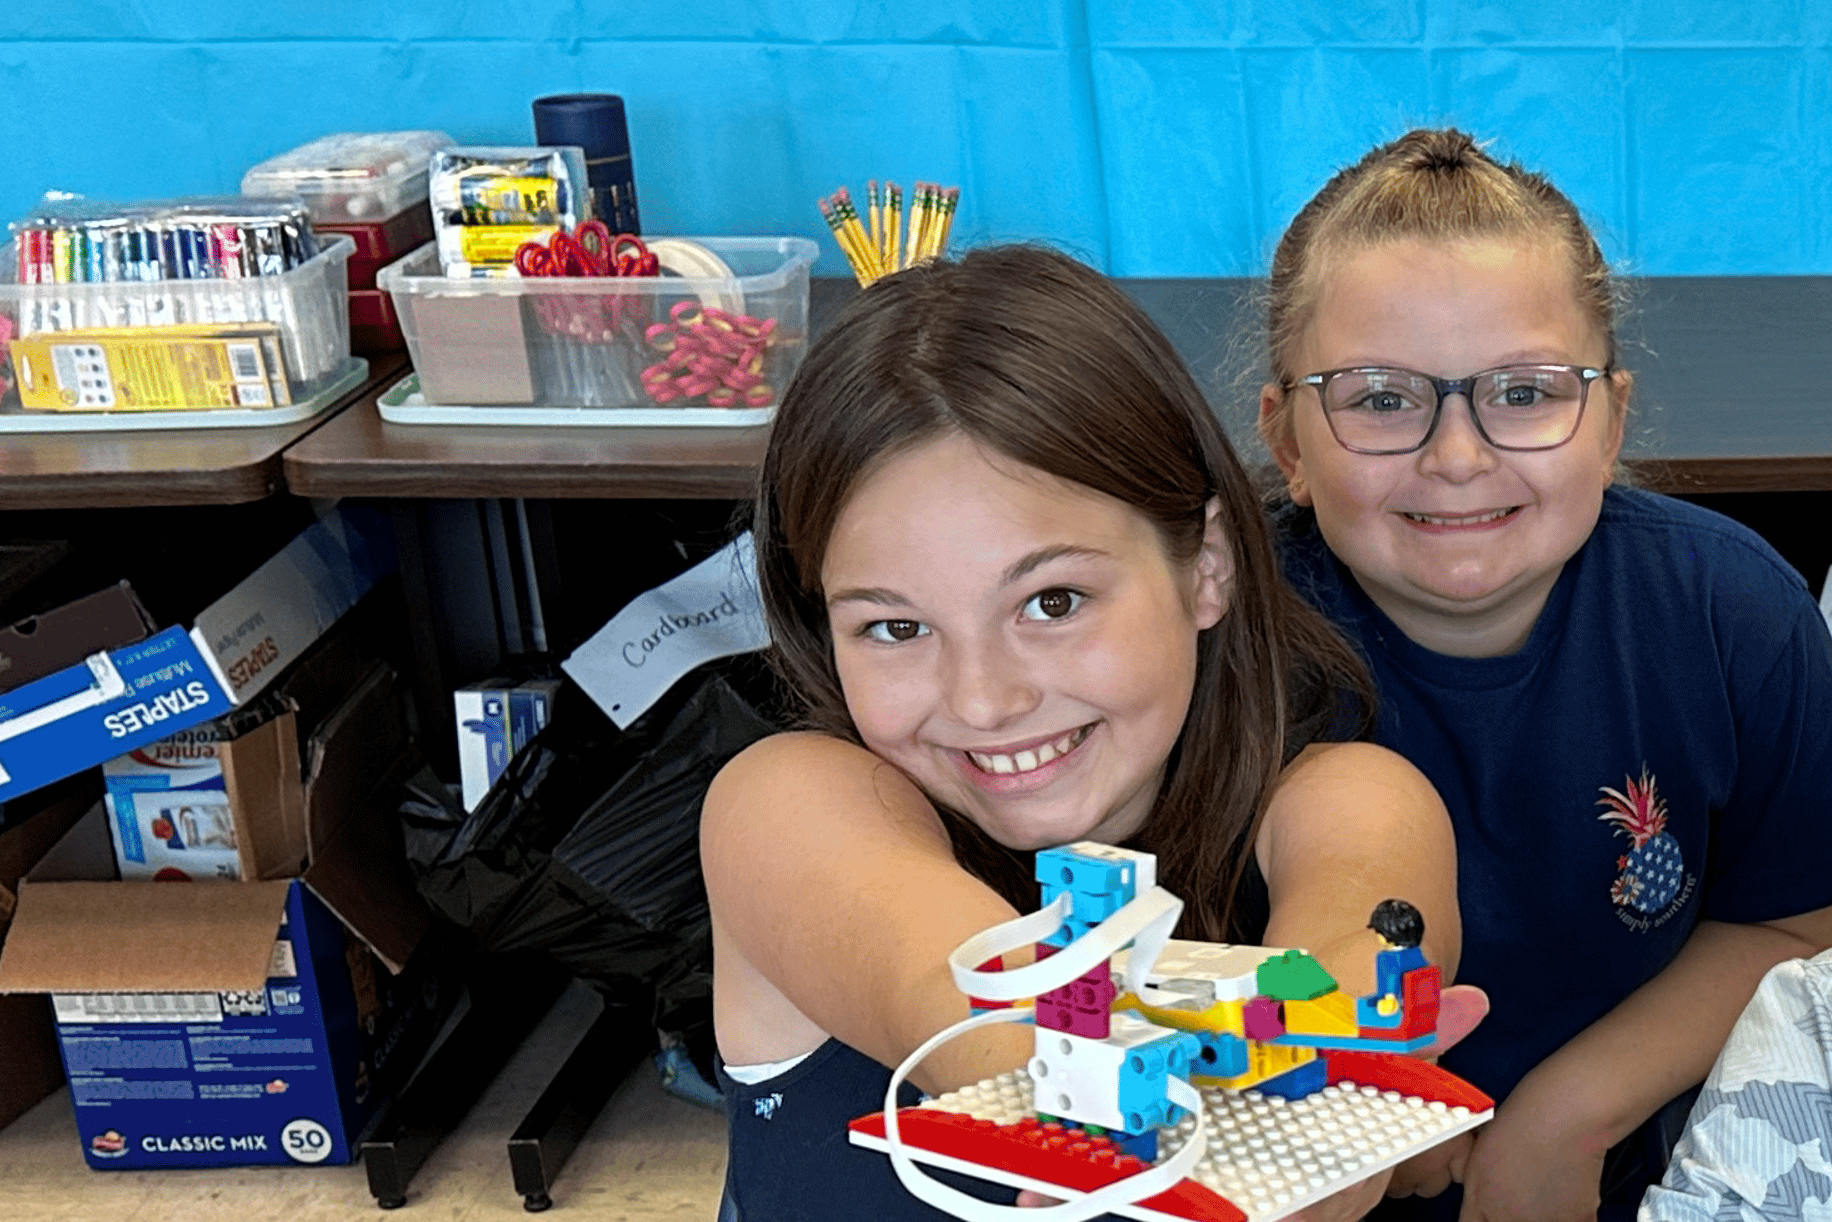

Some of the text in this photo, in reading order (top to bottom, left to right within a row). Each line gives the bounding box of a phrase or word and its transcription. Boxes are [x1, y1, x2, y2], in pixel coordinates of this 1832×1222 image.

[622, 591, 739, 669] Cardboard
[103, 681, 210, 738] STAPLES
[141, 1135, 225, 1152] CLASSIC
[230, 1135, 268, 1151] MIX
[288, 1129, 325, 1149] 50
